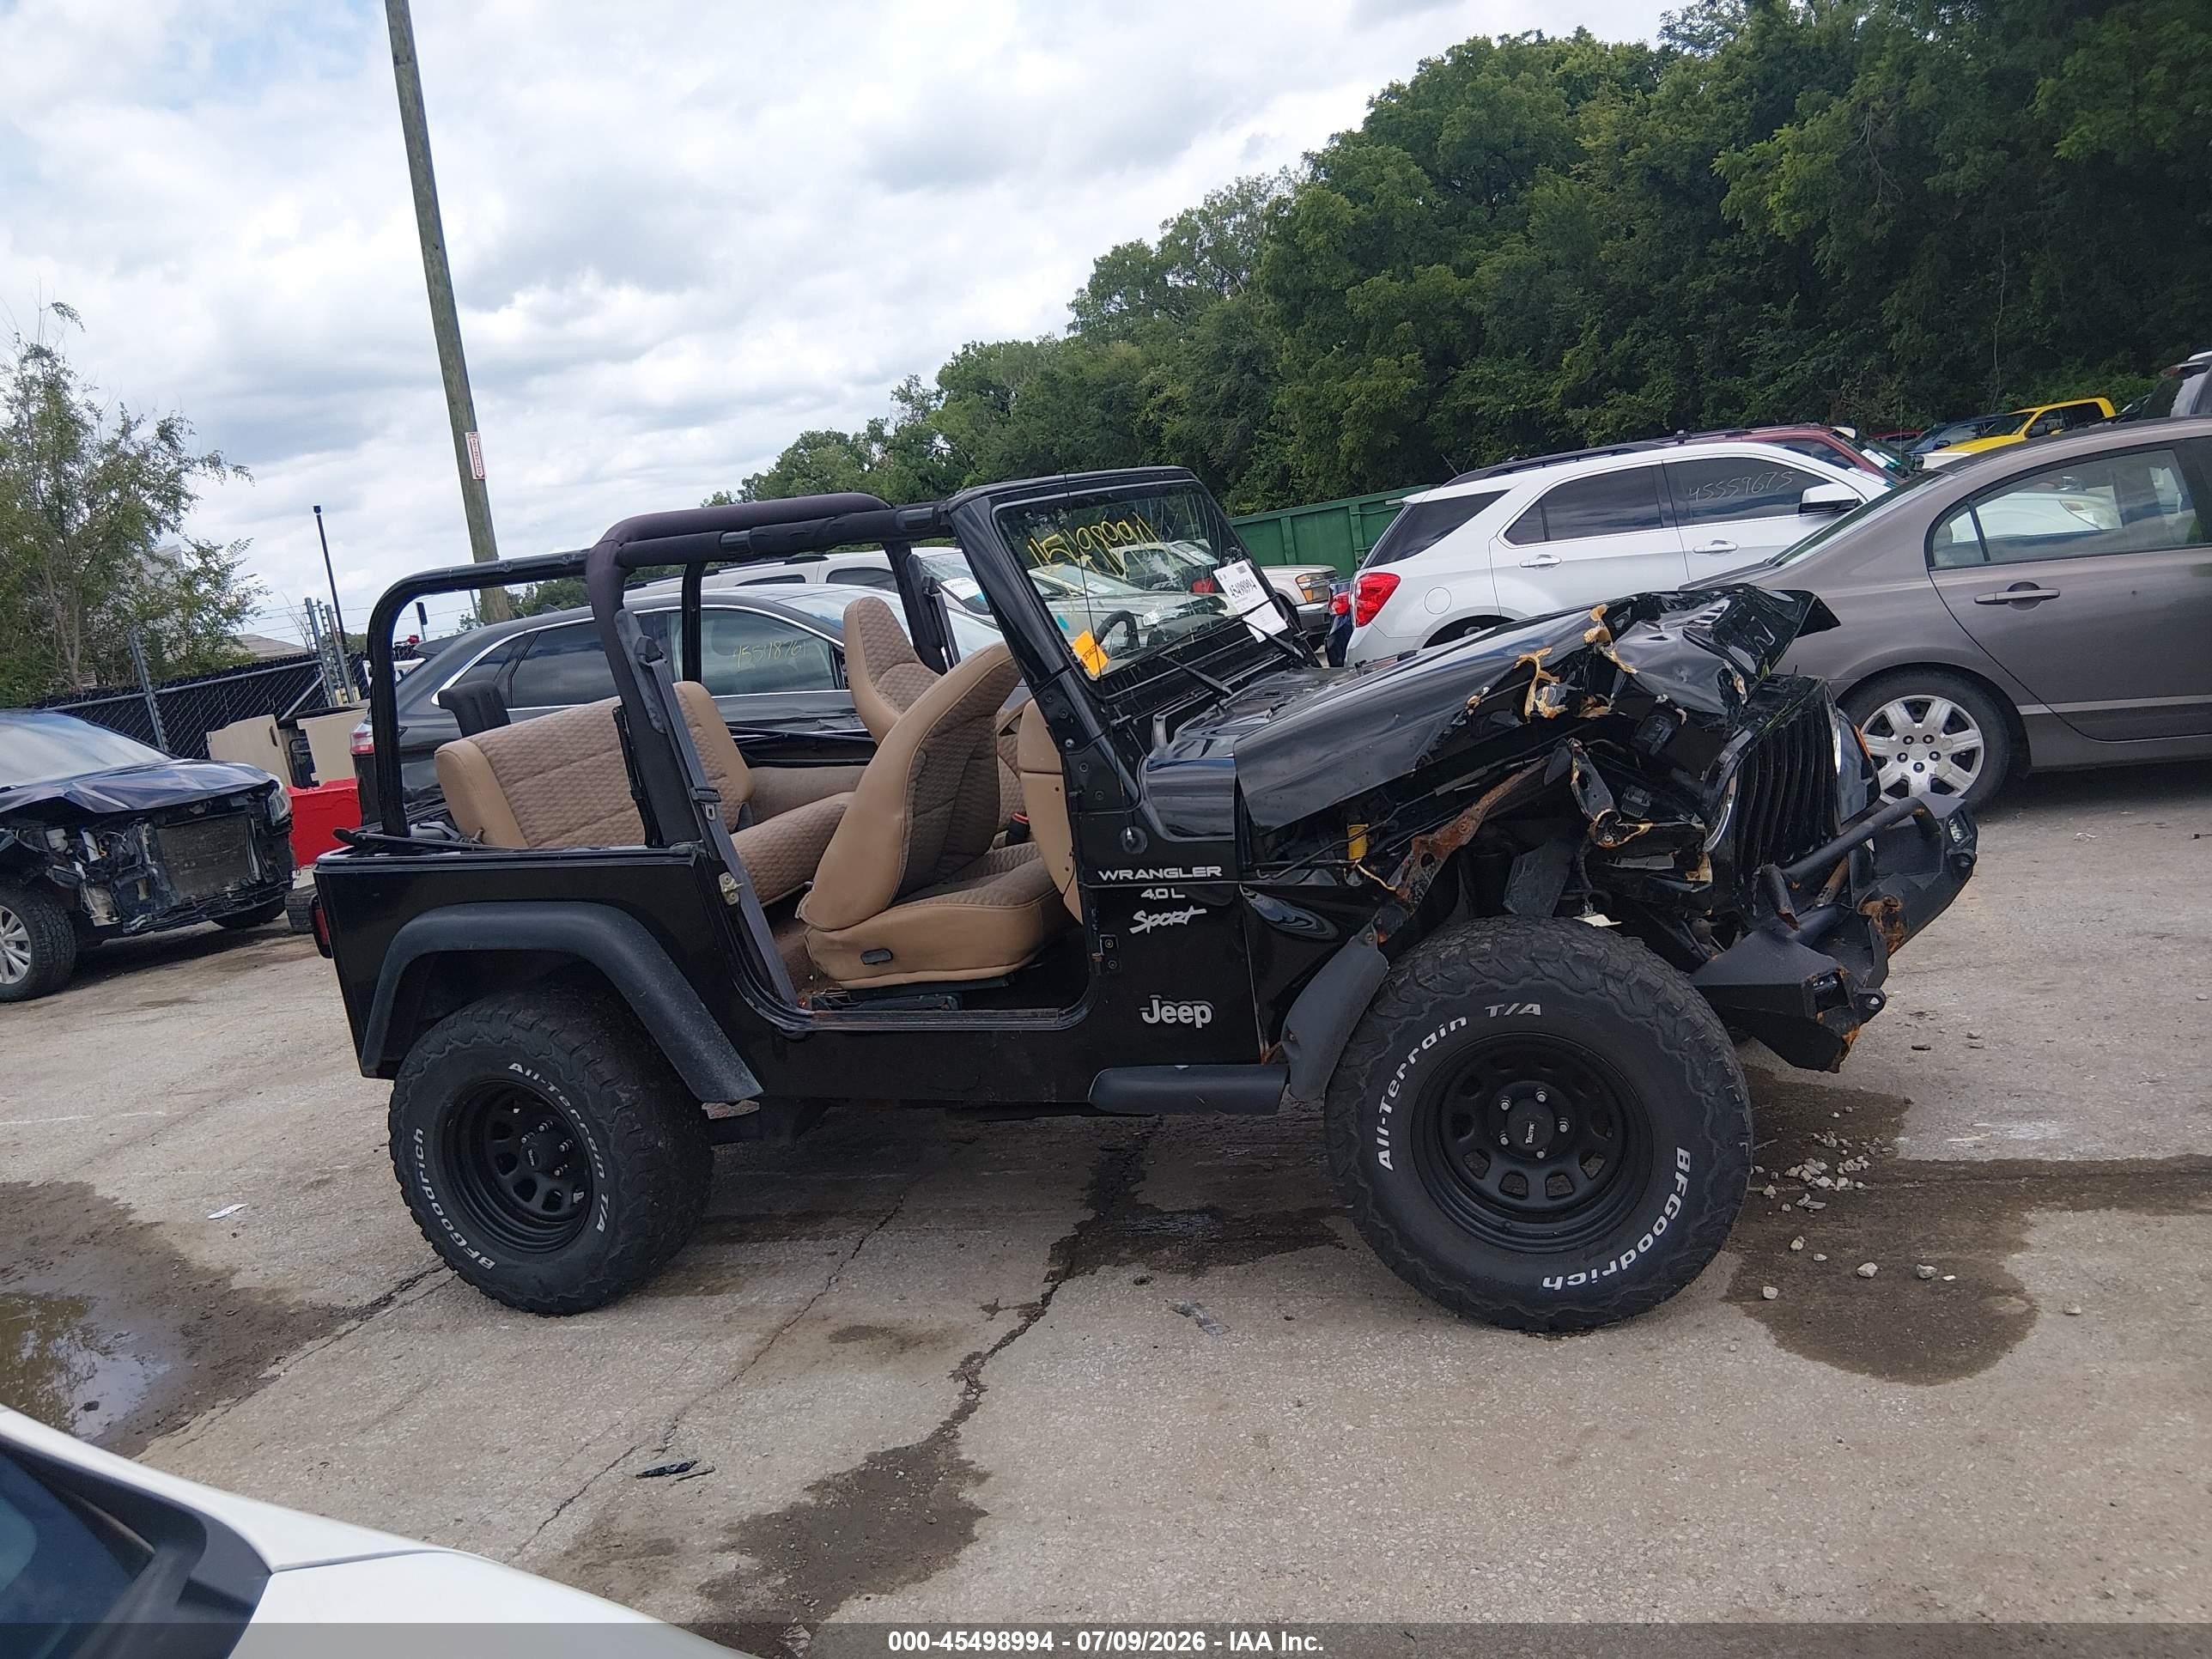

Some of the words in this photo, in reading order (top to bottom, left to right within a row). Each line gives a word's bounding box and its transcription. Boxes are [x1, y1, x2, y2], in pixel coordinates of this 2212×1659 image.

[1688, 471, 1796, 502] 45559675
[1097, 865, 1223, 881] WRANGLER
[1128, 905, 1208, 934] Sport
[1139, 994, 1214, 1029] Jeep
[1376, 1016, 1468, 1172] All-Terrain
[1485, 1002, 1542, 1018] T/A
[508, 1062, 605, 1179] All-Terrain
[597, 1193, 609, 1233] T/A
[413, 1128, 496, 1270] BFGoodrich
[1542, 1146, 1691, 1291] BFGoodrich
